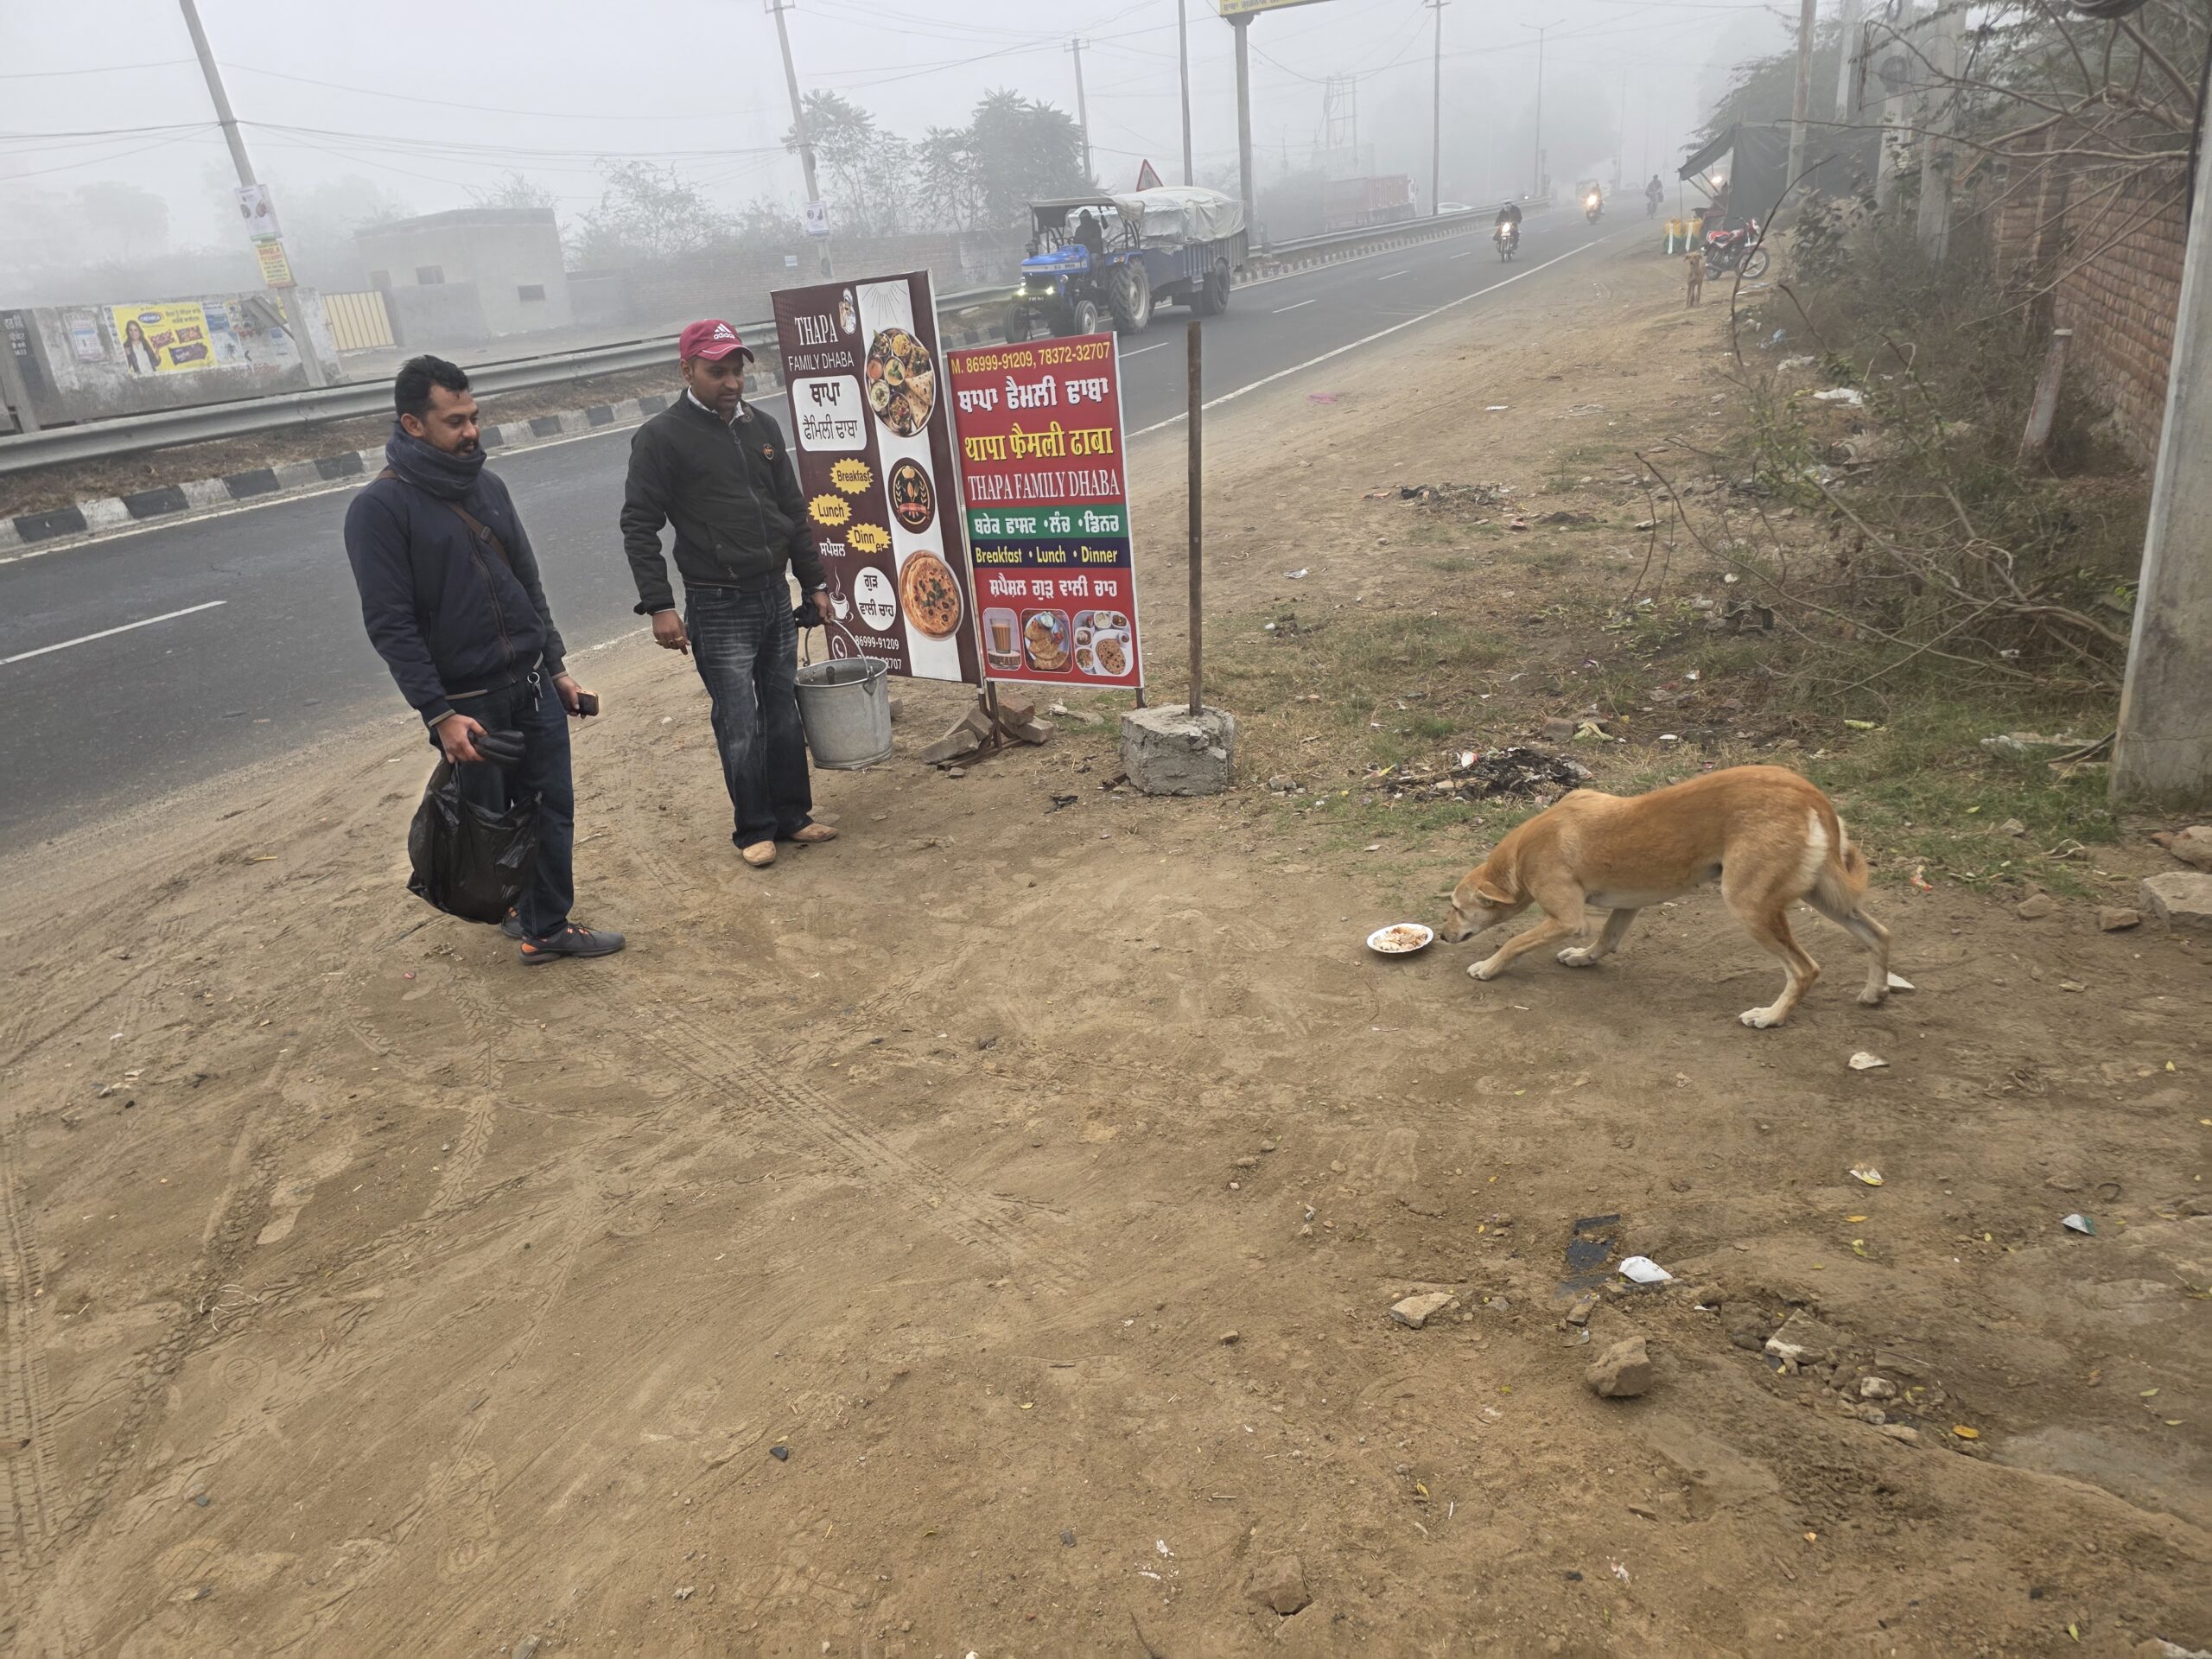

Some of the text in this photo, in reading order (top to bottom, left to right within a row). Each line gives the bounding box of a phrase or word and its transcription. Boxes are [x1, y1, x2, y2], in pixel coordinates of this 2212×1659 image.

[795, 313, 839, 346] THAPA
[788, 351, 855, 372] FAMILY DHABA
[951, 342, 1109, 374] M. 86999-91209, 78372-32707
[809, 382, 841, 407] ਥਾਪਾ
[1006, 375, 1057, 409] ਫੈਮਲੀ
[835, 420, 857, 439] ਢਾਬਾ
[964, 423, 1113, 461] थापा फैमली ढाबा
[836, 470, 871, 481] Breakfast
[968, 468, 1121, 500] THAPA FAMILY DHABA
[818, 504, 844, 518] Lunch
[975, 545, 1118, 563] Breakfast Lunch Dinner
[1059, 575, 1089, 597] ਵਾਲੀ
[1094, 580, 1117, 597] ਚਾਹ
[859, 599, 893, 617] ਵਾਲੀ ਚਾਹ
[855, 635, 899, 650] 86999-91209
